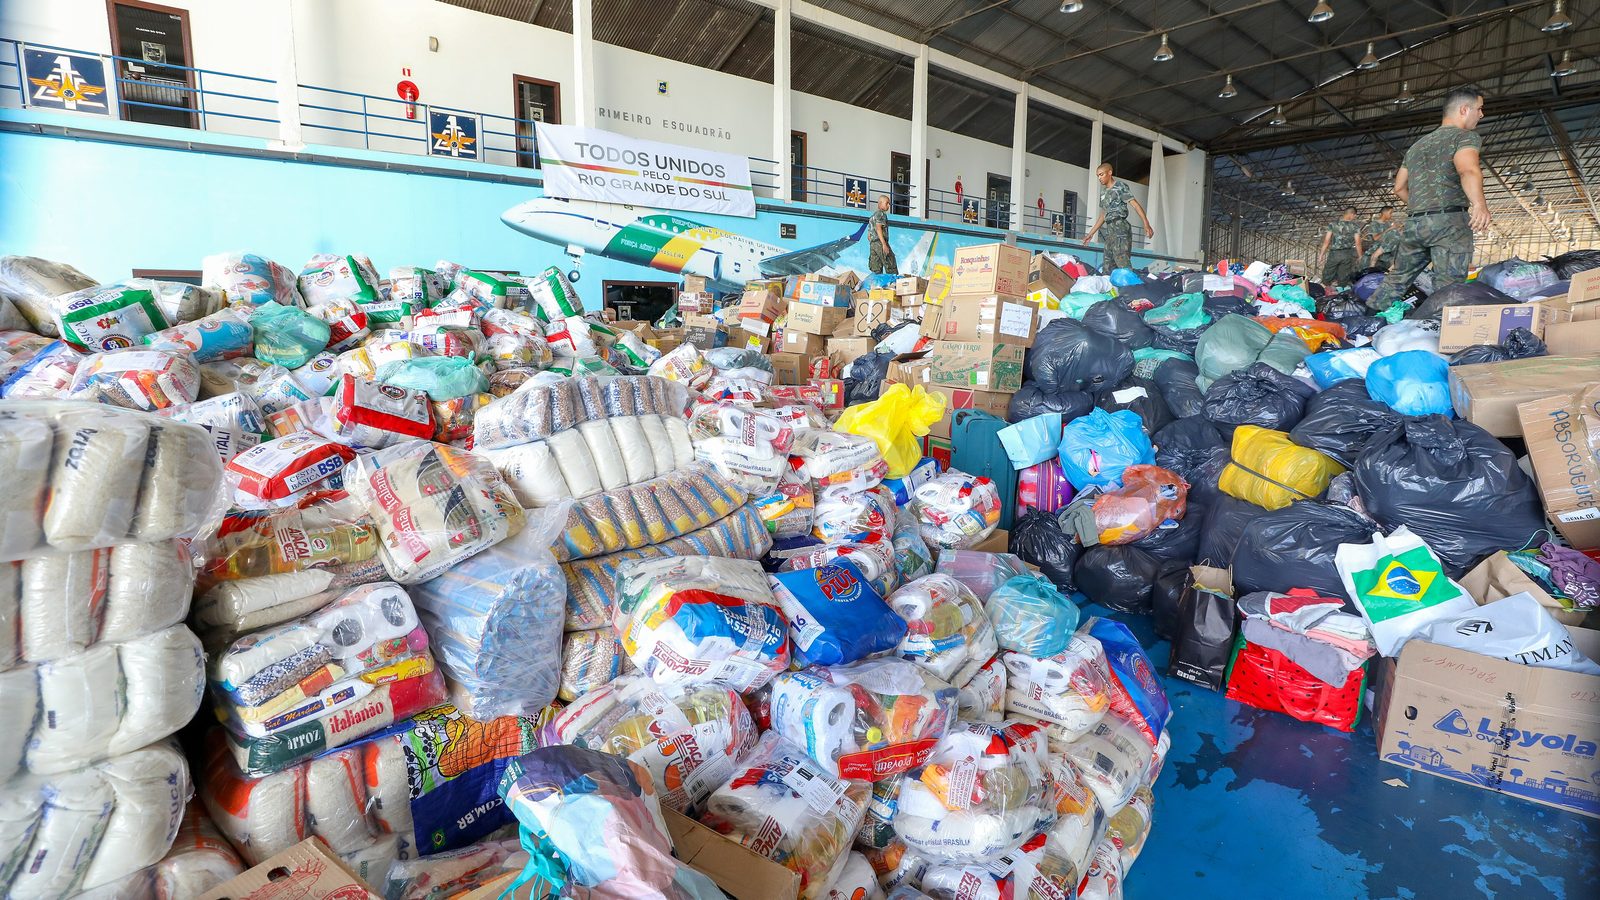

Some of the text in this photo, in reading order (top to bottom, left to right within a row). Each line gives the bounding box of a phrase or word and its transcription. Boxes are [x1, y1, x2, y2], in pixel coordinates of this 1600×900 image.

[595, 107, 732, 140] RIMEIRO ESQUADRÃO
[574, 142, 726, 178] TODOS UNIDOS
[642, 170, 671, 181] PELO
[578, 173, 732, 202] RIO GRANDE DO SUL
[621, 238, 638, 249] FORÇA
[68, 298, 94, 310] BSB
[290, 468, 317, 483] CESTA
[317, 456, 343, 476] BSB
[790, 614, 806, 633] 16
[652, 646, 709, 676] ATACADISTA
[329, 701, 384, 734] italianão
[288, 728, 320, 750] arroz
[1476, 717, 1599, 757] Loyola
